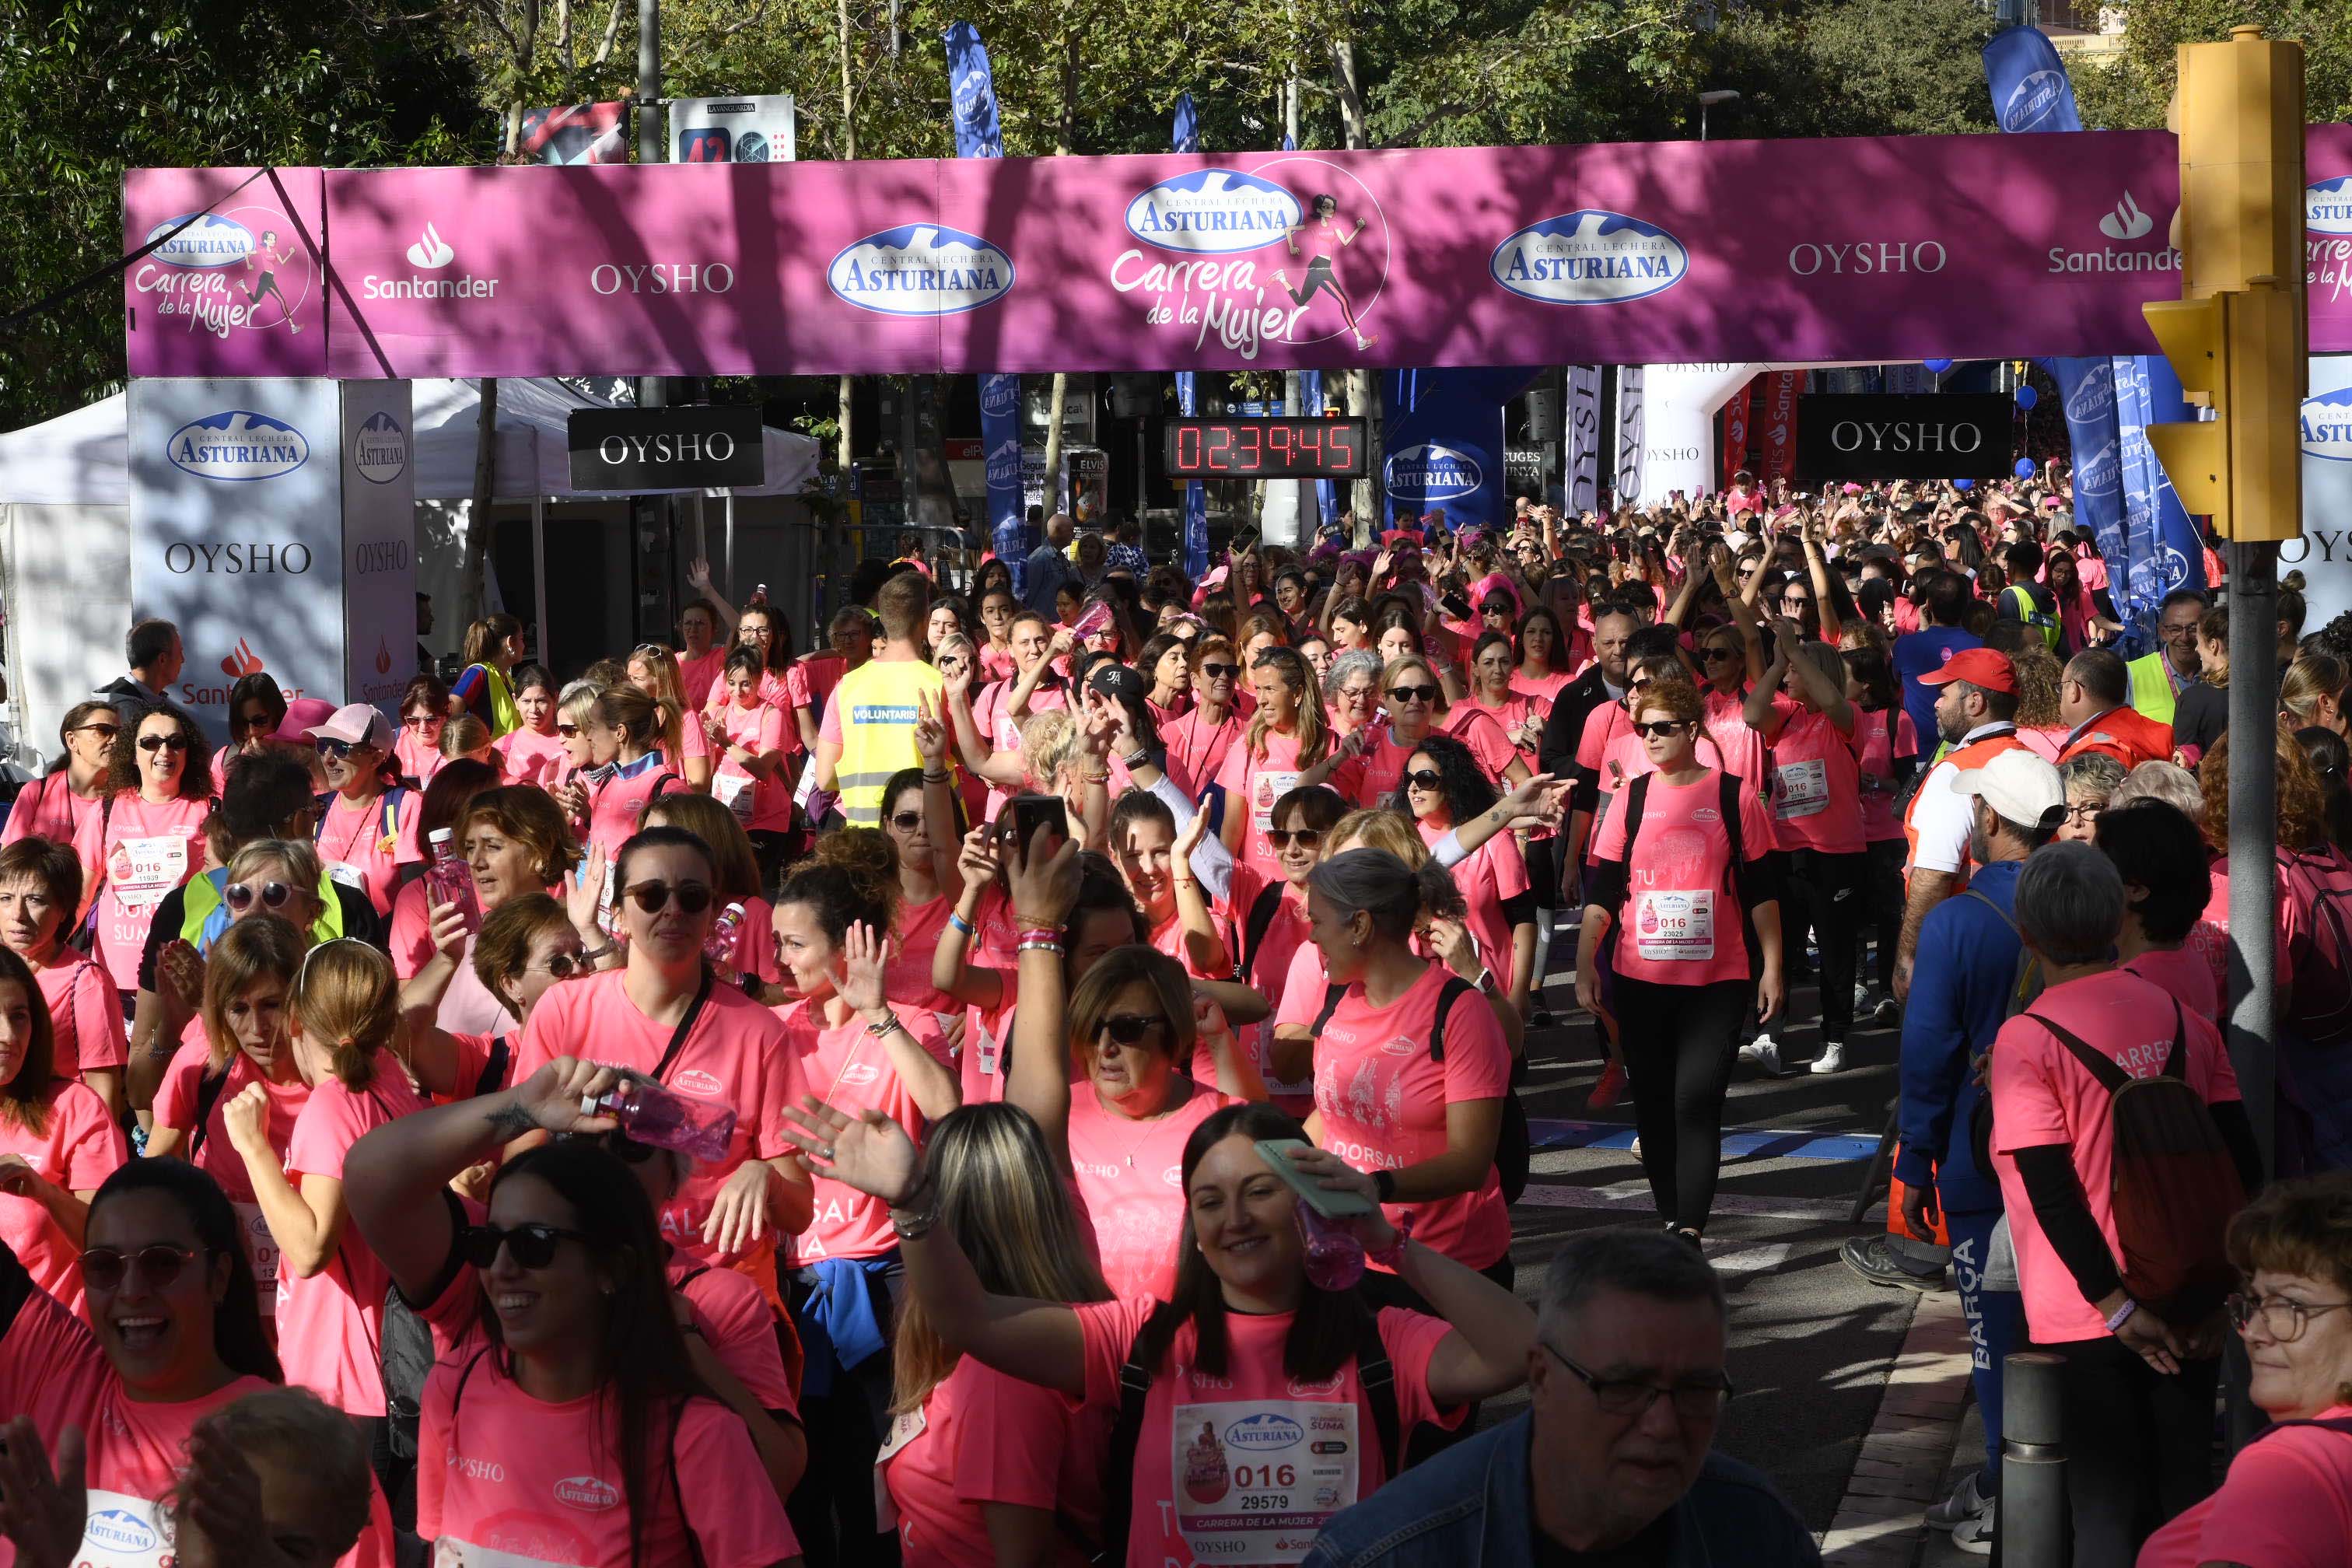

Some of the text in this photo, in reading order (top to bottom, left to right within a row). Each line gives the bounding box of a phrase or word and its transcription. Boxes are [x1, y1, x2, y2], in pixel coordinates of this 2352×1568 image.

[717, 104, 754, 113] VANGUARDIA
[1166, 197, 1283, 207] CENTRAL LECHERA
[1139, 200, 1288, 233] ASTURIANA
[152, 236, 247, 254] ASTURIANA
[1535, 241, 1667, 252] CENTRAL LECHERA
[871, 254, 995, 264] CENTRAL LECHERA
[1506, 245, 1673, 282] ASTURIANA
[1789, 241, 1947, 275] OYSHO
[135, 264, 227, 293] Carrera
[590, 263, 734, 295] OYSHO
[842, 257, 1000, 293] ASTURIANA
[1111, 249, 1256, 292] Carrera
[2320, 262, 2335, 283] la
[363, 275, 499, 299] Santander
[158, 296, 191, 314] de la
[189, 292, 261, 339] Mujer
[1146, 293, 1199, 324] de la
[1195, 286, 1310, 360] Mujer
[1178, 426, 1351, 469] 02:39:45
[1832, 420, 1982, 453] OYSHO
[179, 436, 299, 464] ASTURIANA
[359, 439, 404, 466] ASTURIANA
[599, 432, 734, 466] OYSHO
[1080, 460, 1104, 471] ELVIS
[1388, 467, 1475, 488] ASTURIANA
[164, 542, 312, 574] OYSHO
[355, 540, 408, 575] OYSHO
[182, 683, 305, 705] Santer
[362, 681, 405, 704] Santander
[853, 709, 916, 720] VOLUNTARIS
[1788, 782, 1807, 793] 016
[135, 862, 161, 873] 016
[138, 874, 159, 883] 11939
[1636, 869, 1654, 886] TU
[1661, 918, 1686, 928] 016
[1321, 1024, 1356, 1045] OYSHO
[677, 1076, 719, 1091] ASTURIANA
[1953, 1237, 1991, 1370] BARÇA
[1230, 1428, 1299, 1443] ASTURIANA
[1310, 1421, 1345, 1430] SUMA
[446, 1447, 505, 1482] OYSHO
[1234, 1464, 1297, 1488] 016
[558, 1486, 614, 1504] ASTURIANA
[1241, 1495, 1289, 1510] 29579
[86, 1519, 149, 1548] ASTURIANA
[1196, 1518, 1244, 1529] CARRERA
[1246, 1517, 1261, 1527] DE
[1262, 1517, 1276, 1527] LA
[1278, 1516, 1314, 1526] MUJER
[1194, 1540, 1245, 1554] OYSHO
